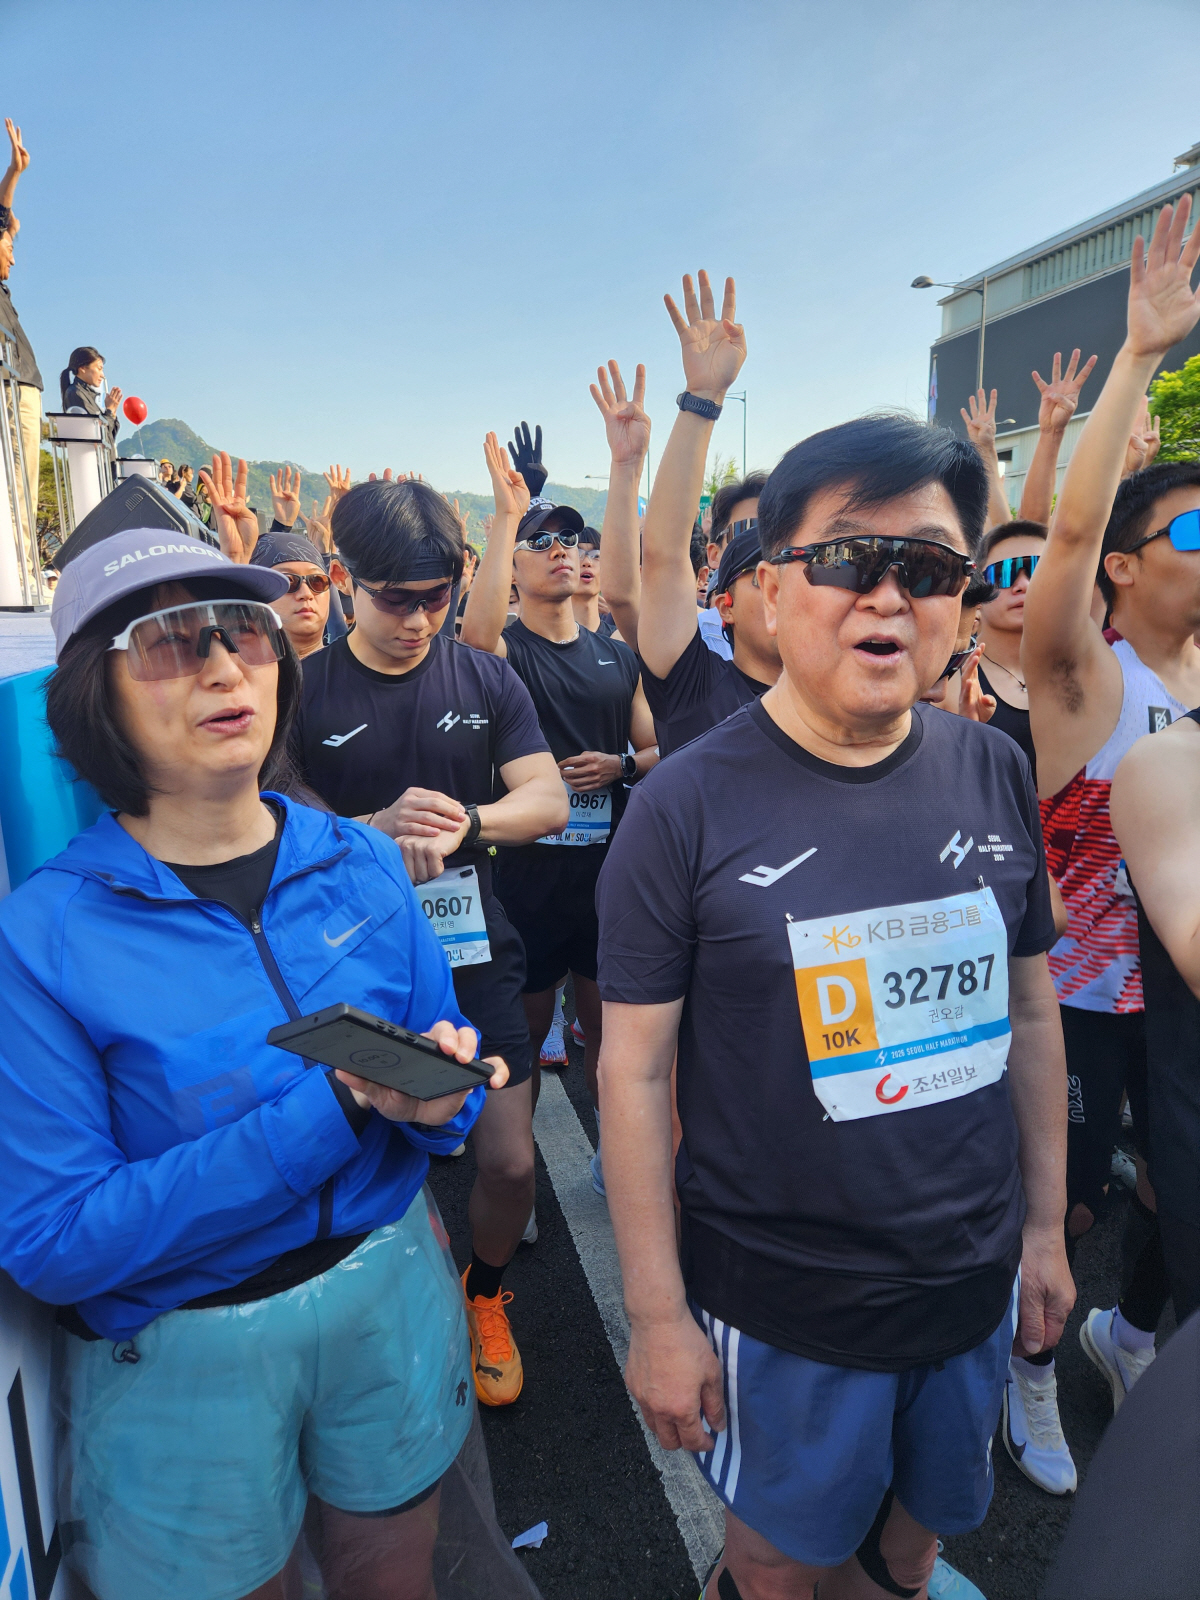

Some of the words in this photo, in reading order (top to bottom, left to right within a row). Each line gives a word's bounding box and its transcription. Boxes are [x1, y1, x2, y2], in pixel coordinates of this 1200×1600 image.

[104, 544, 224, 577] SALOMON
[568, 793, 607, 809] 0967
[421, 896, 472, 919] 0607
[447, 949, 464, 962] OUL
[883, 953, 995, 1009] 32787
[816, 975, 857, 1026] D
[929, 1005, 964, 1023] 권오갑
[822, 1028, 862, 1050] 10K
[891, 1049, 905, 1059] 2026
[907, 1045, 925, 1055] SEOUL
[925, 1041, 939, 1051] HALF
[940, 1035, 968, 1048] MARATHON
[912, 1065, 978, 1095] 조선일보
